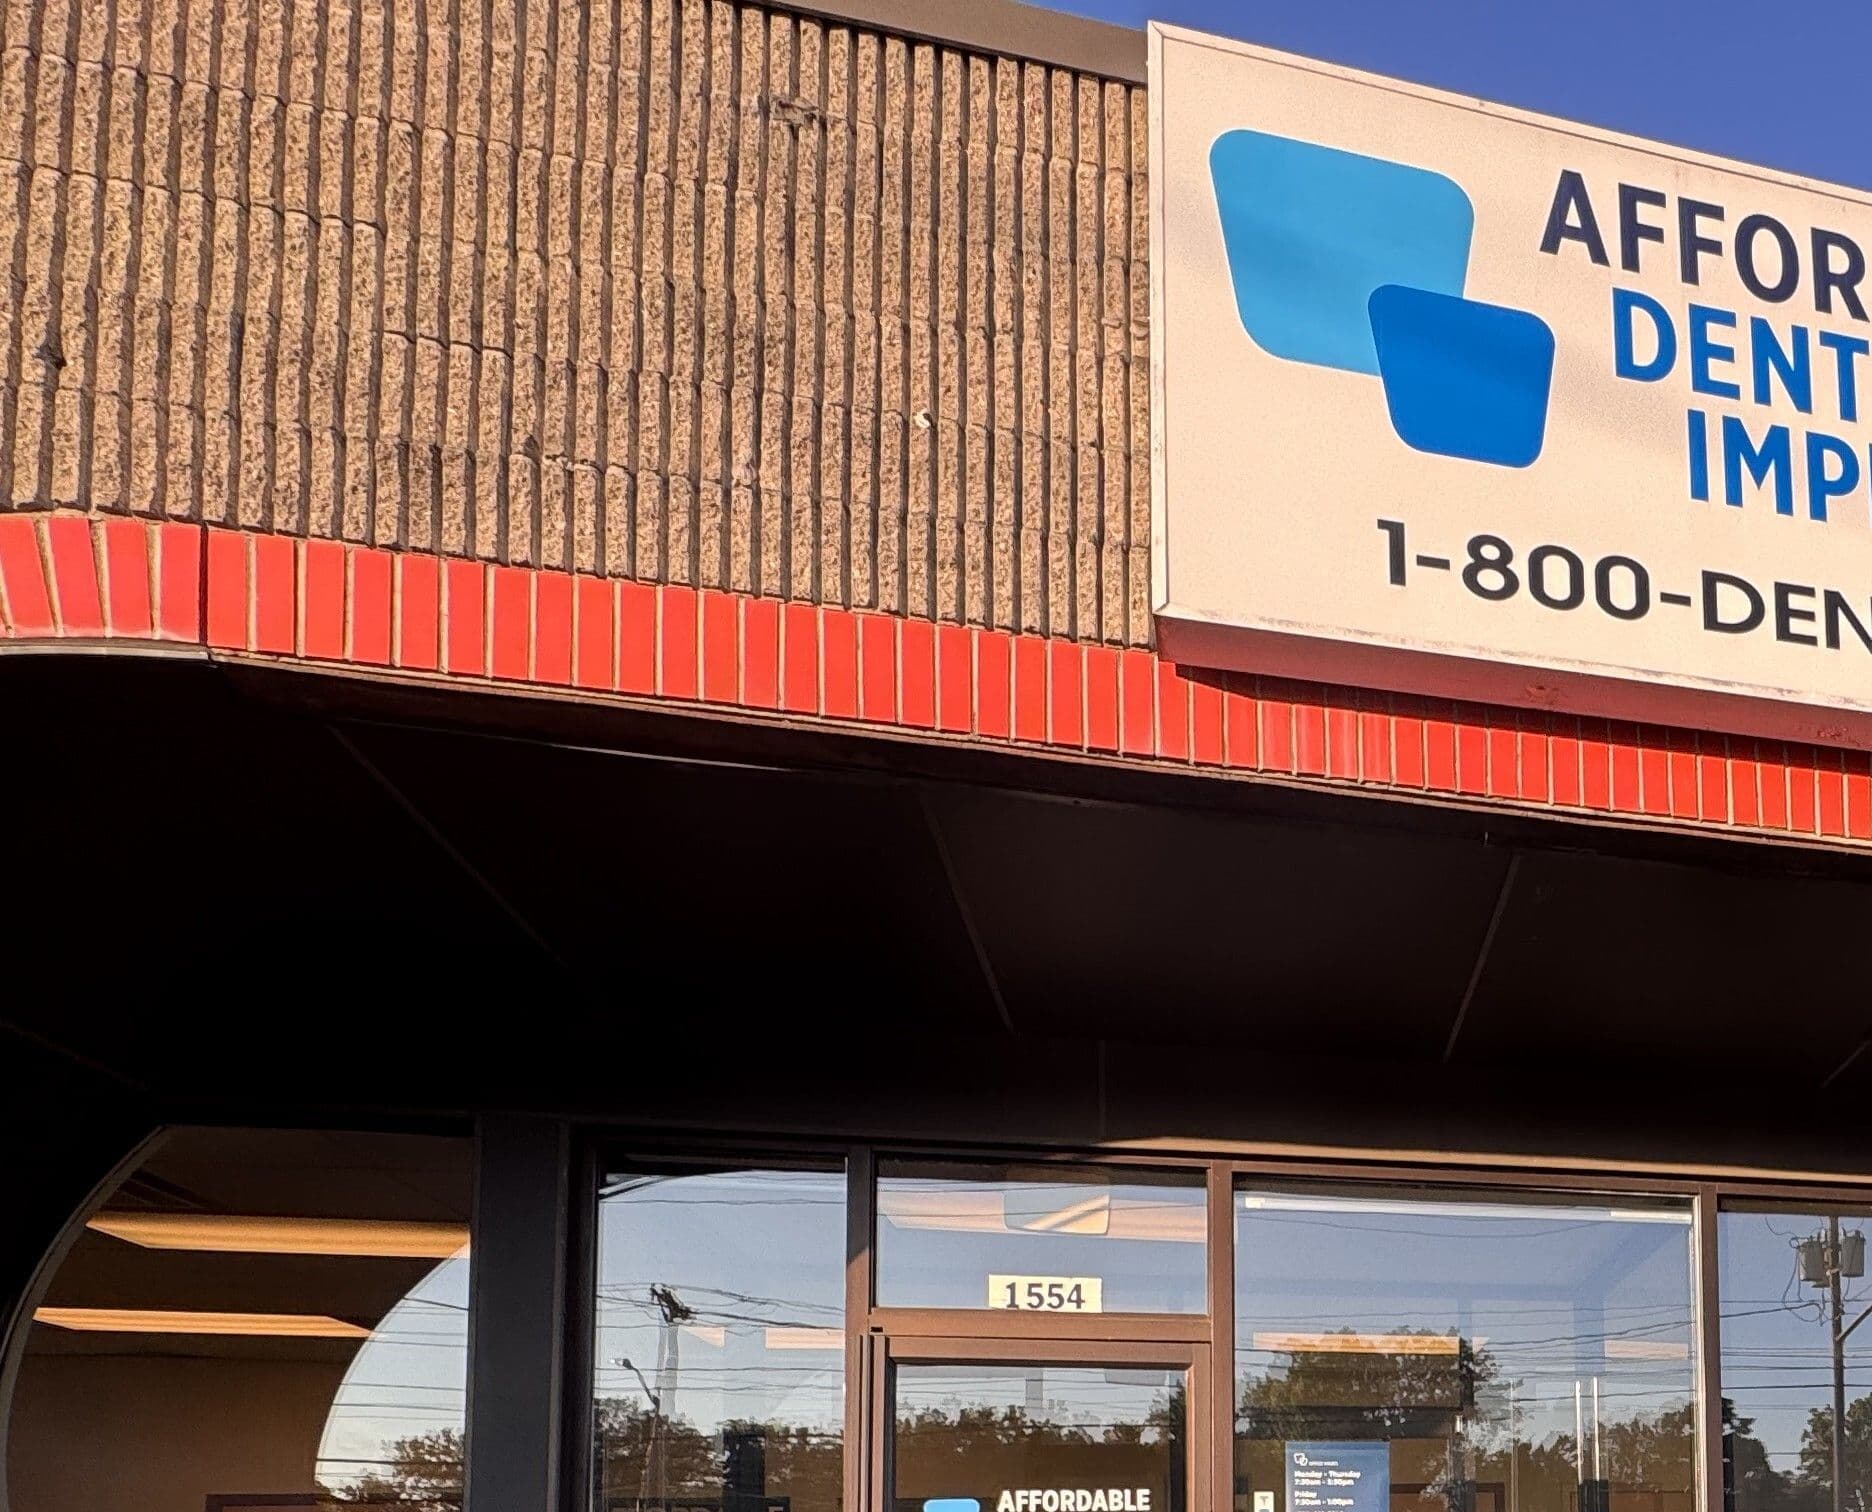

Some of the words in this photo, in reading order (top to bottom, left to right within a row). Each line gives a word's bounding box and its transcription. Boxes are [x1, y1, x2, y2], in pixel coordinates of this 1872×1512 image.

[1005, 1281, 1086, 1310] 1554
[1328, 1470, 1361, 1479] Thursday
[997, 1489, 1151, 1512] AFFORDABLE
